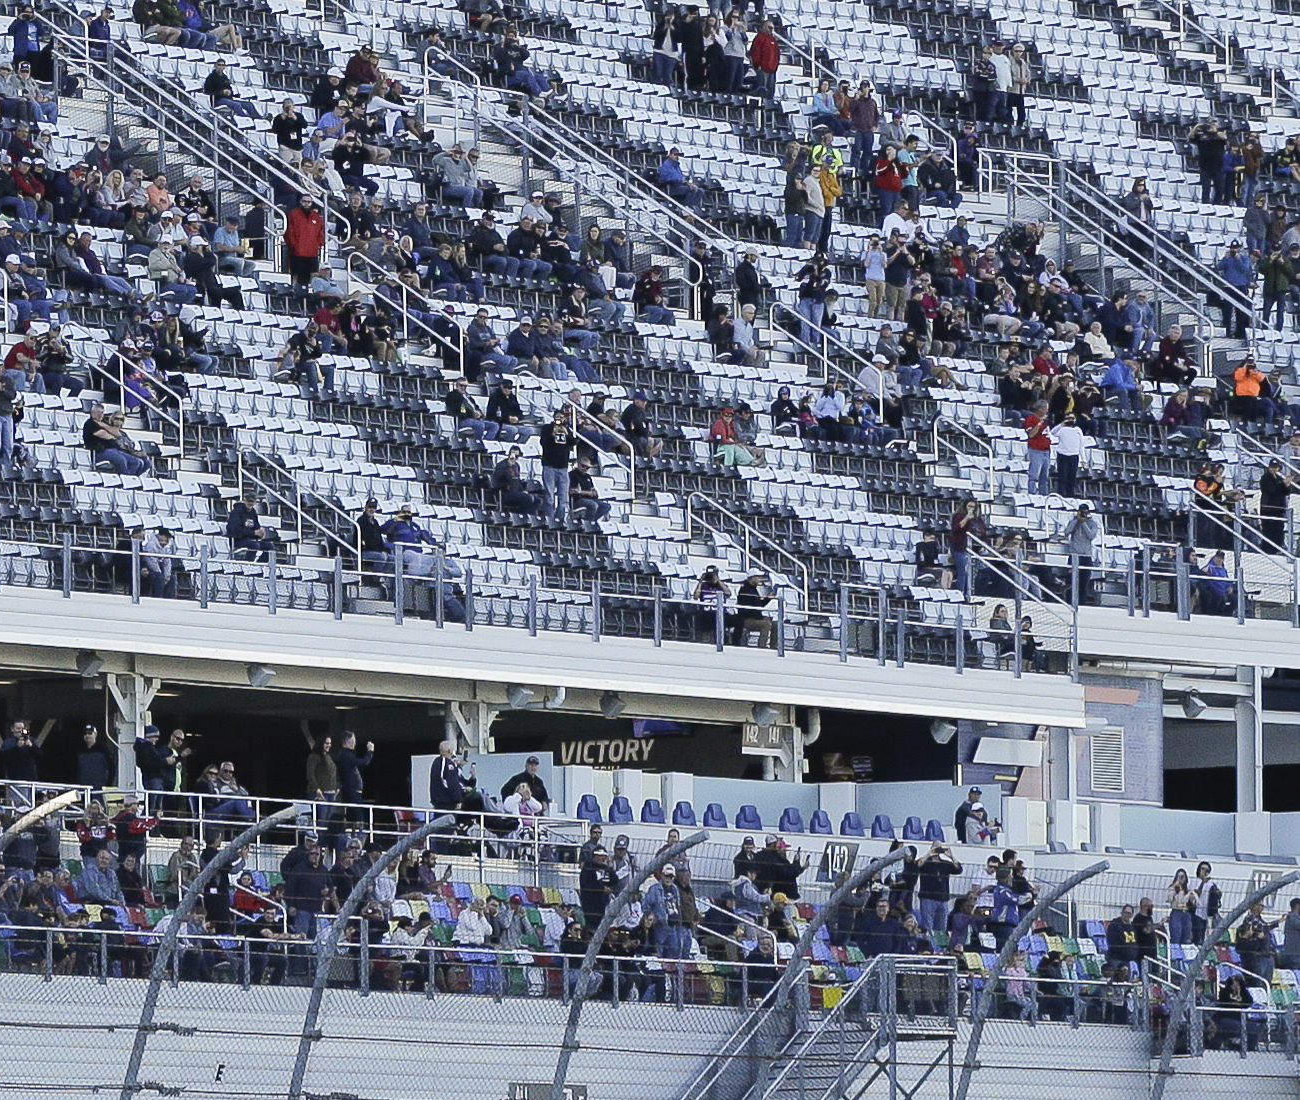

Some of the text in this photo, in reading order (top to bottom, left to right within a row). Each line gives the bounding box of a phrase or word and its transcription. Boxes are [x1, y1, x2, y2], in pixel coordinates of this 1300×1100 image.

[561, 739, 655, 764] VICTORY
[826, 844, 849, 880] 142
[215, 1064, 226, 1083] E
